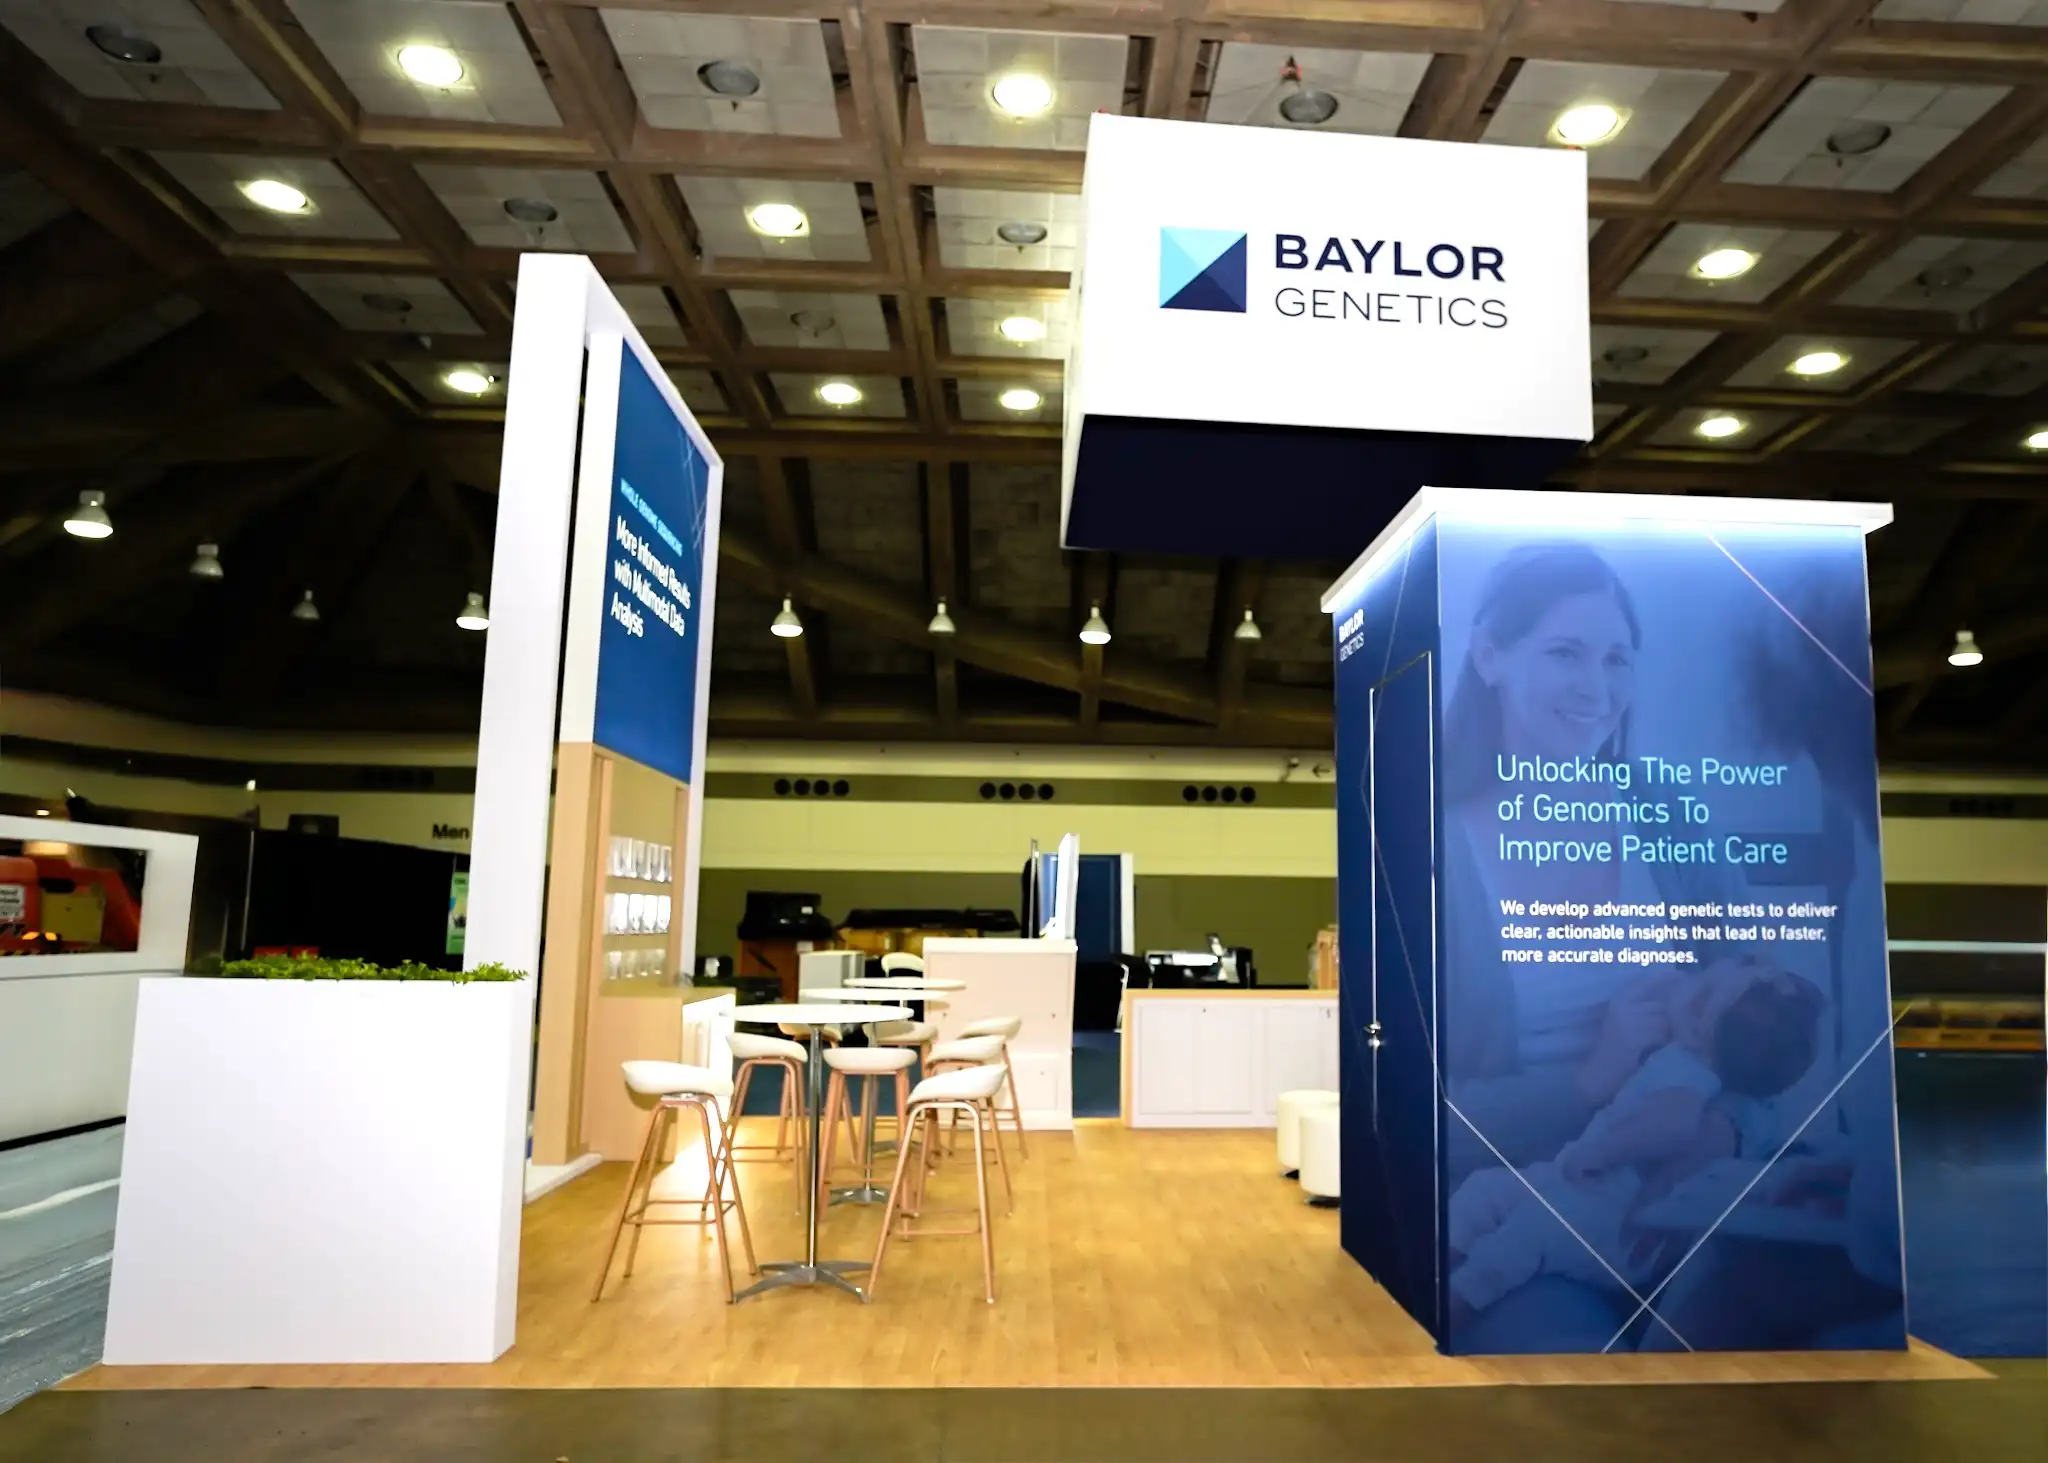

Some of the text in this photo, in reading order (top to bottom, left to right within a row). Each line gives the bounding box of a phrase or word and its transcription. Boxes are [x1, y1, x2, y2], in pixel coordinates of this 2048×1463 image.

[1275, 233, 1506, 282] BAYLOR
[1275, 287, 1508, 329] GENETICS
[616, 514, 637, 557] More
[637, 535, 669, 588] Informed
[611, 592, 643, 637] Analysis
[614, 559, 632, 591] with
[669, 603, 685, 637] Data
[1498, 754, 1788, 789] Unlocking The Power
[1498, 794, 1709, 824] of Genomics To
[432, 823, 470, 839] Men
[1500, 833, 1788, 867] Improve Patient Care
[1500, 900, 1838, 920] We develop advanced genetic tests to deliver
[1501, 923, 1826, 943] clear, actionable insights that lead to faster,
[1502, 948, 1698, 966] more accurate diagnoses.
